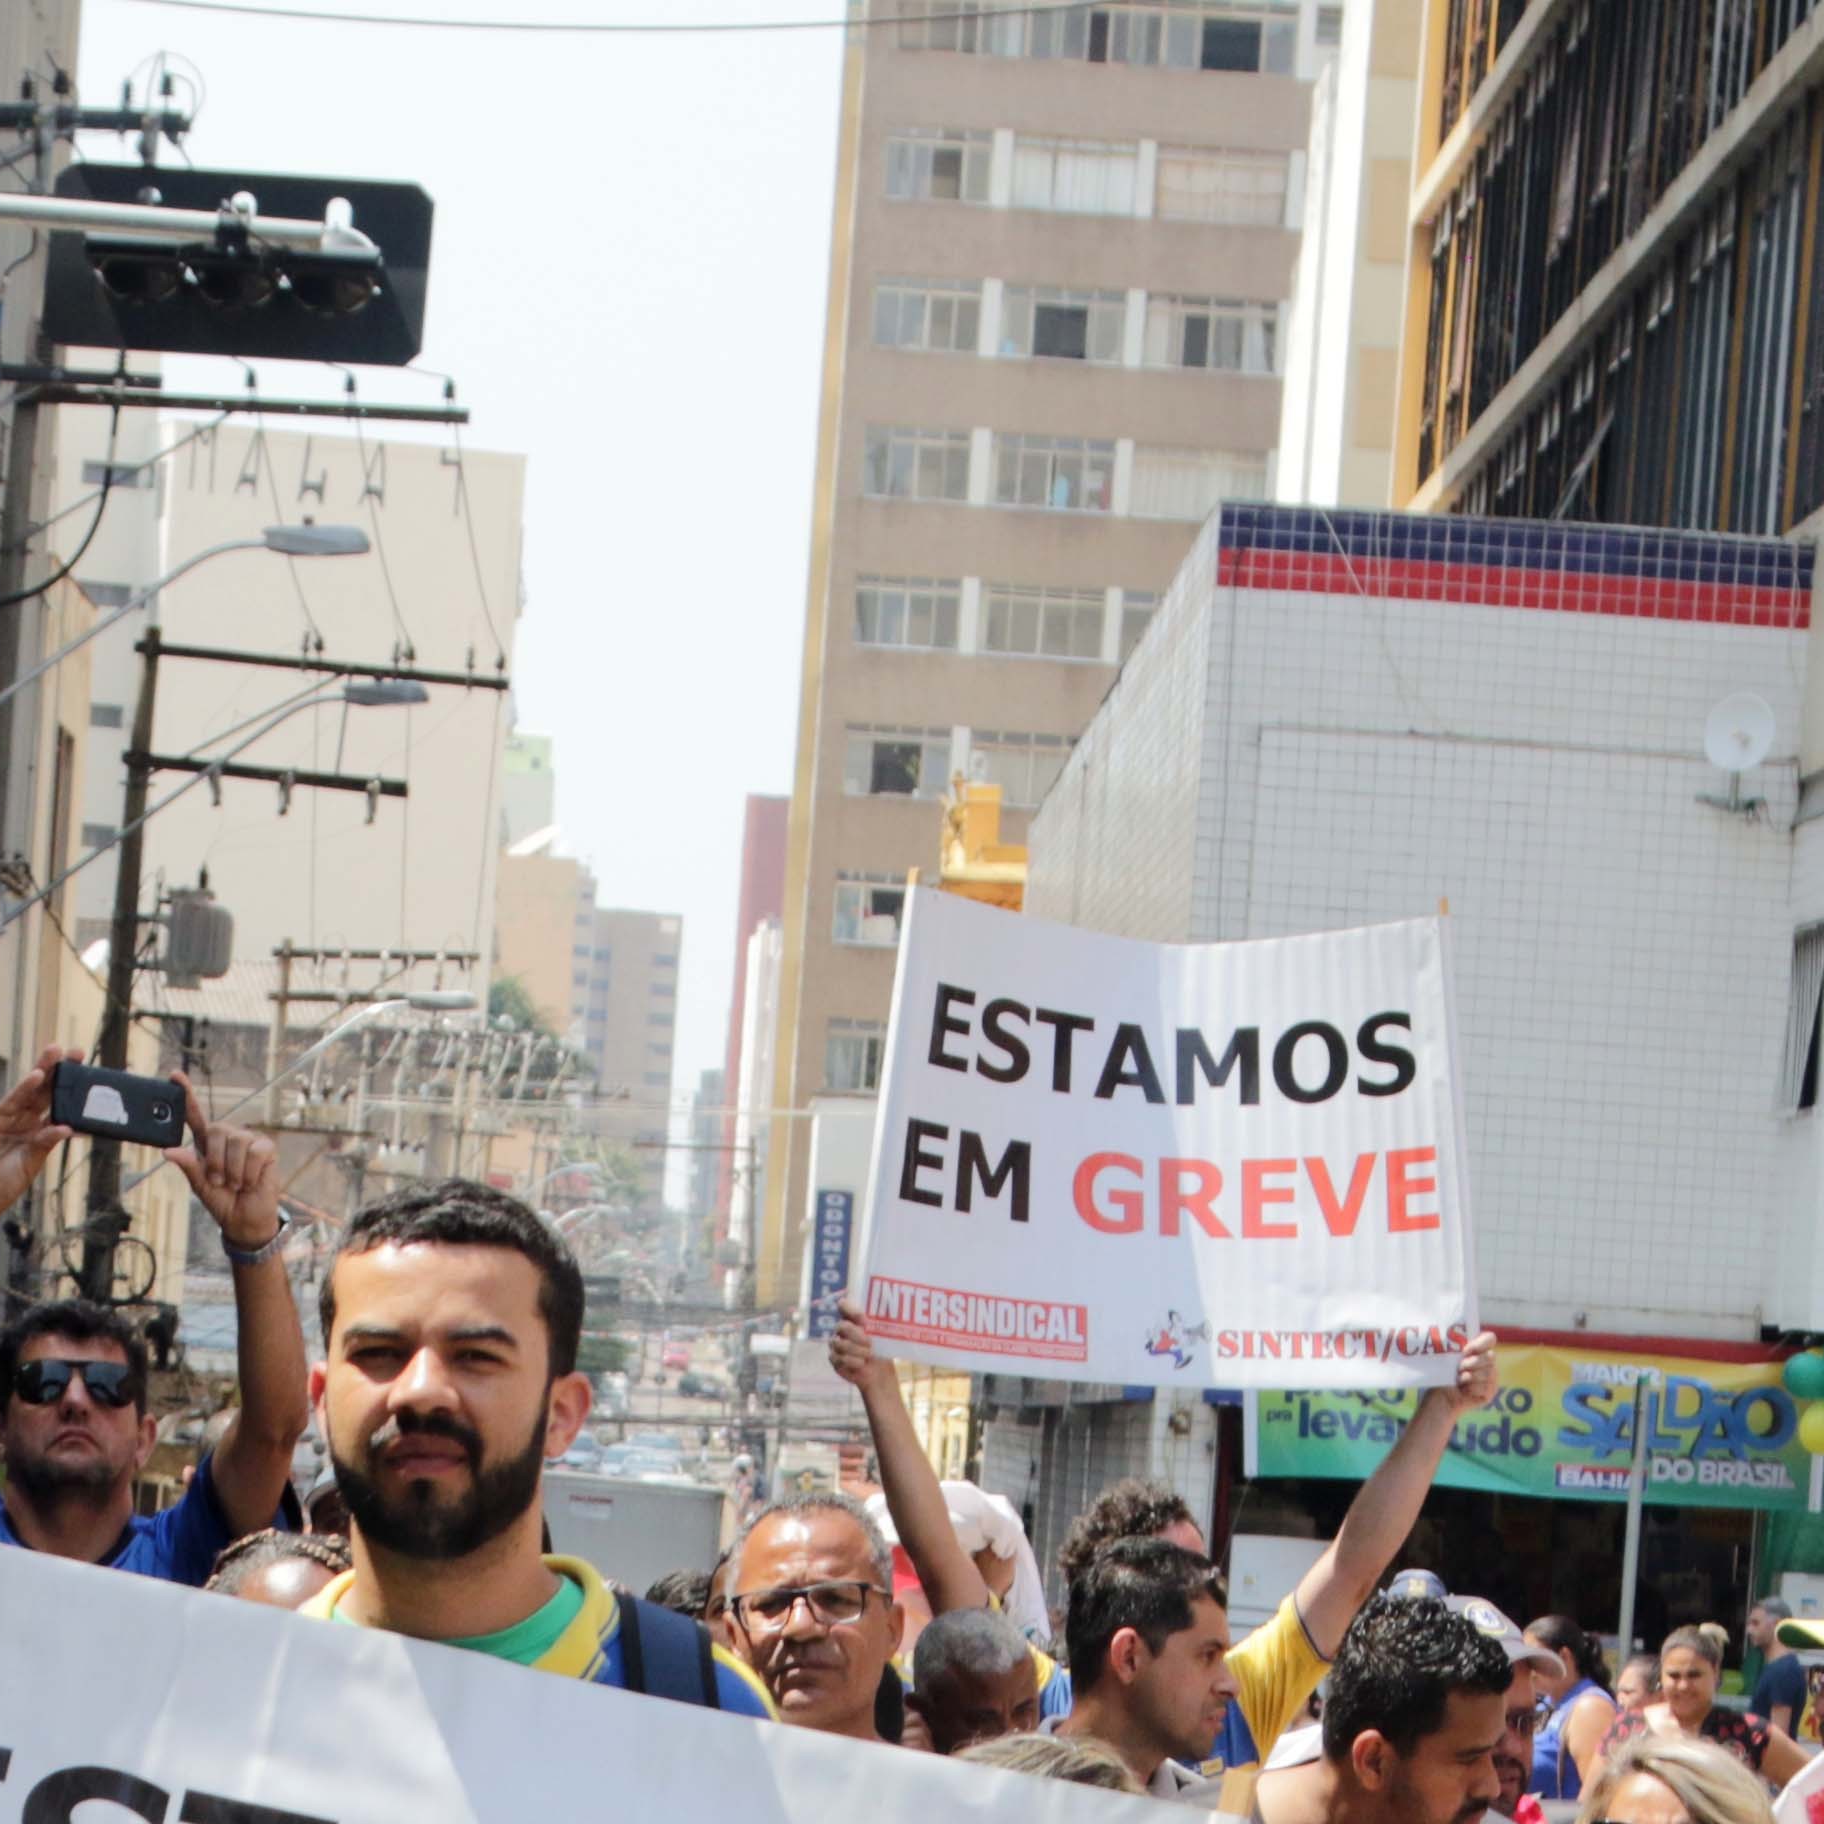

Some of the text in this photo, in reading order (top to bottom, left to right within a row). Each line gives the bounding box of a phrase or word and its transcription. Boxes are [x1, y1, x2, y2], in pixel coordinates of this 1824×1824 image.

[928, 982, 1416, 1105] ESTAMOS
[899, 1117, 1440, 1239] EM GREVE
[869, 1279, 1085, 1344] INTERSINDICAL
[1217, 1323, 1468, 1363] SINTECT/CAS
[1450, 1416, 1543, 1456] udo
[1651, 1456, 1795, 1489] DO BRASIL
